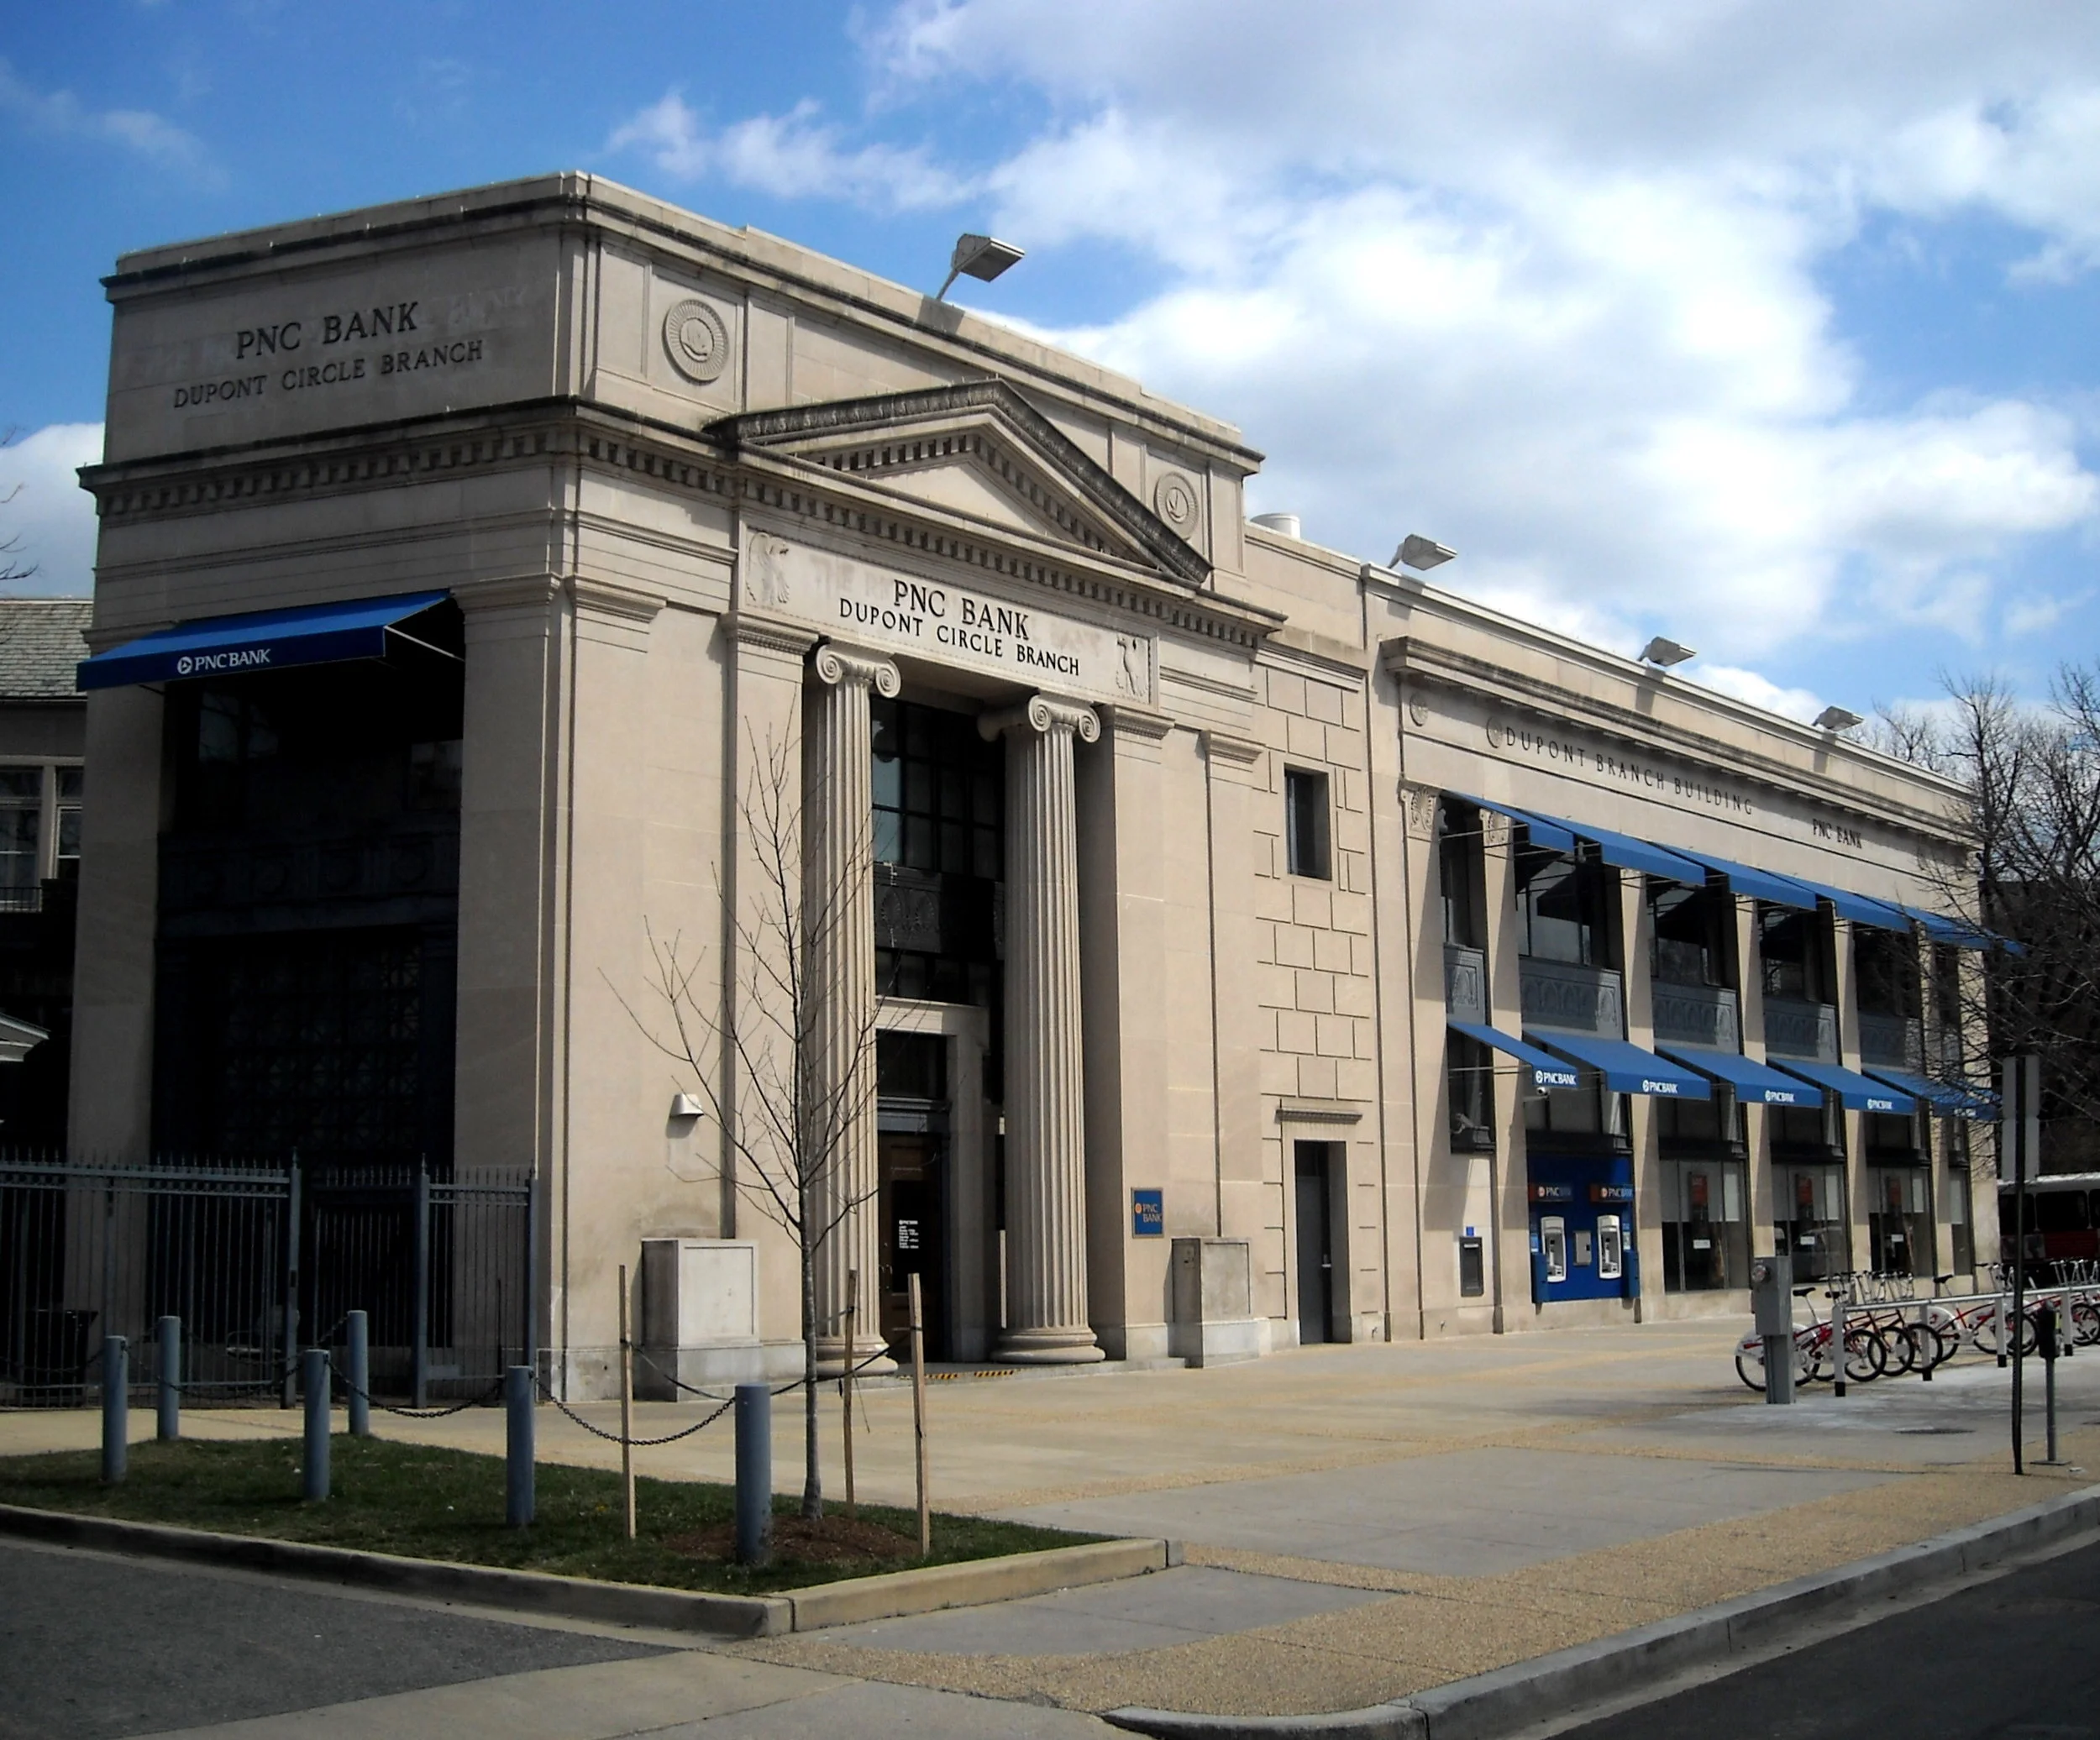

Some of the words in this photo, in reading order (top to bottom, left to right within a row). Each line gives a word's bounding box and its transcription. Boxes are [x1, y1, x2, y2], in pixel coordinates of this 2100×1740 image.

[236, 322, 302, 359] PNC
[323, 301, 419, 345] BANK
[174, 375, 268, 408] DUPONT
[281, 359, 366, 391] CIRCLE
[381, 339, 484, 375] BRANCH
[839, 597, 924, 637] DUPONT
[937, 625, 1004, 658] CIRCLE
[1016, 643, 1080, 676] BRANCH
[894, 579, 946, 617] PNC
[961, 597, 1030, 640] BANK
[1505, 726, 1586, 768] DUPONT
[1596, 757, 1666, 791] BRANCH
[1674, 778, 1754, 815] BUILDING
[1812, 818, 1833, 840] PNC
[1836, 825, 1862, 849] BANK
[1142, 1203, 1158, 1213] PNC
[1143, 1213, 1163, 1224] BANK
